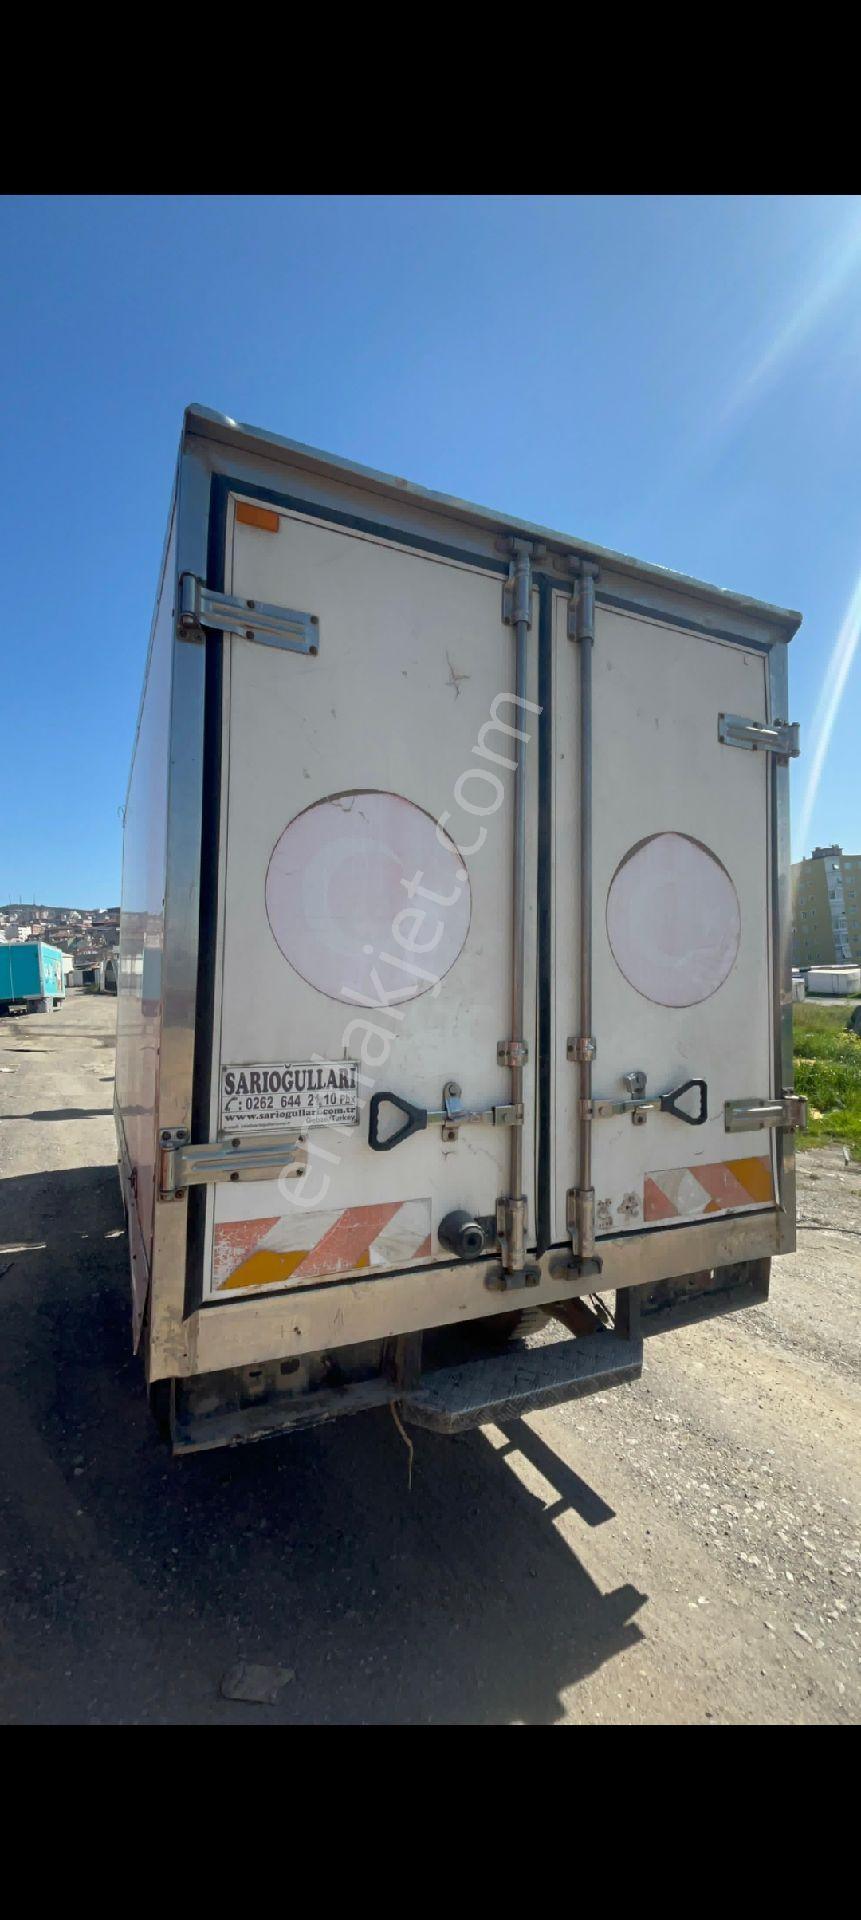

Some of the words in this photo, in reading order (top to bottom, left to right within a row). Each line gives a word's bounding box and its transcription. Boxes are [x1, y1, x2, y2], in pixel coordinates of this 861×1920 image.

[224, 1064, 357, 1095] SARIOĞULLARI
[280, 1094, 302, 1108] 644
[323, 1092, 337, 1105] 10
